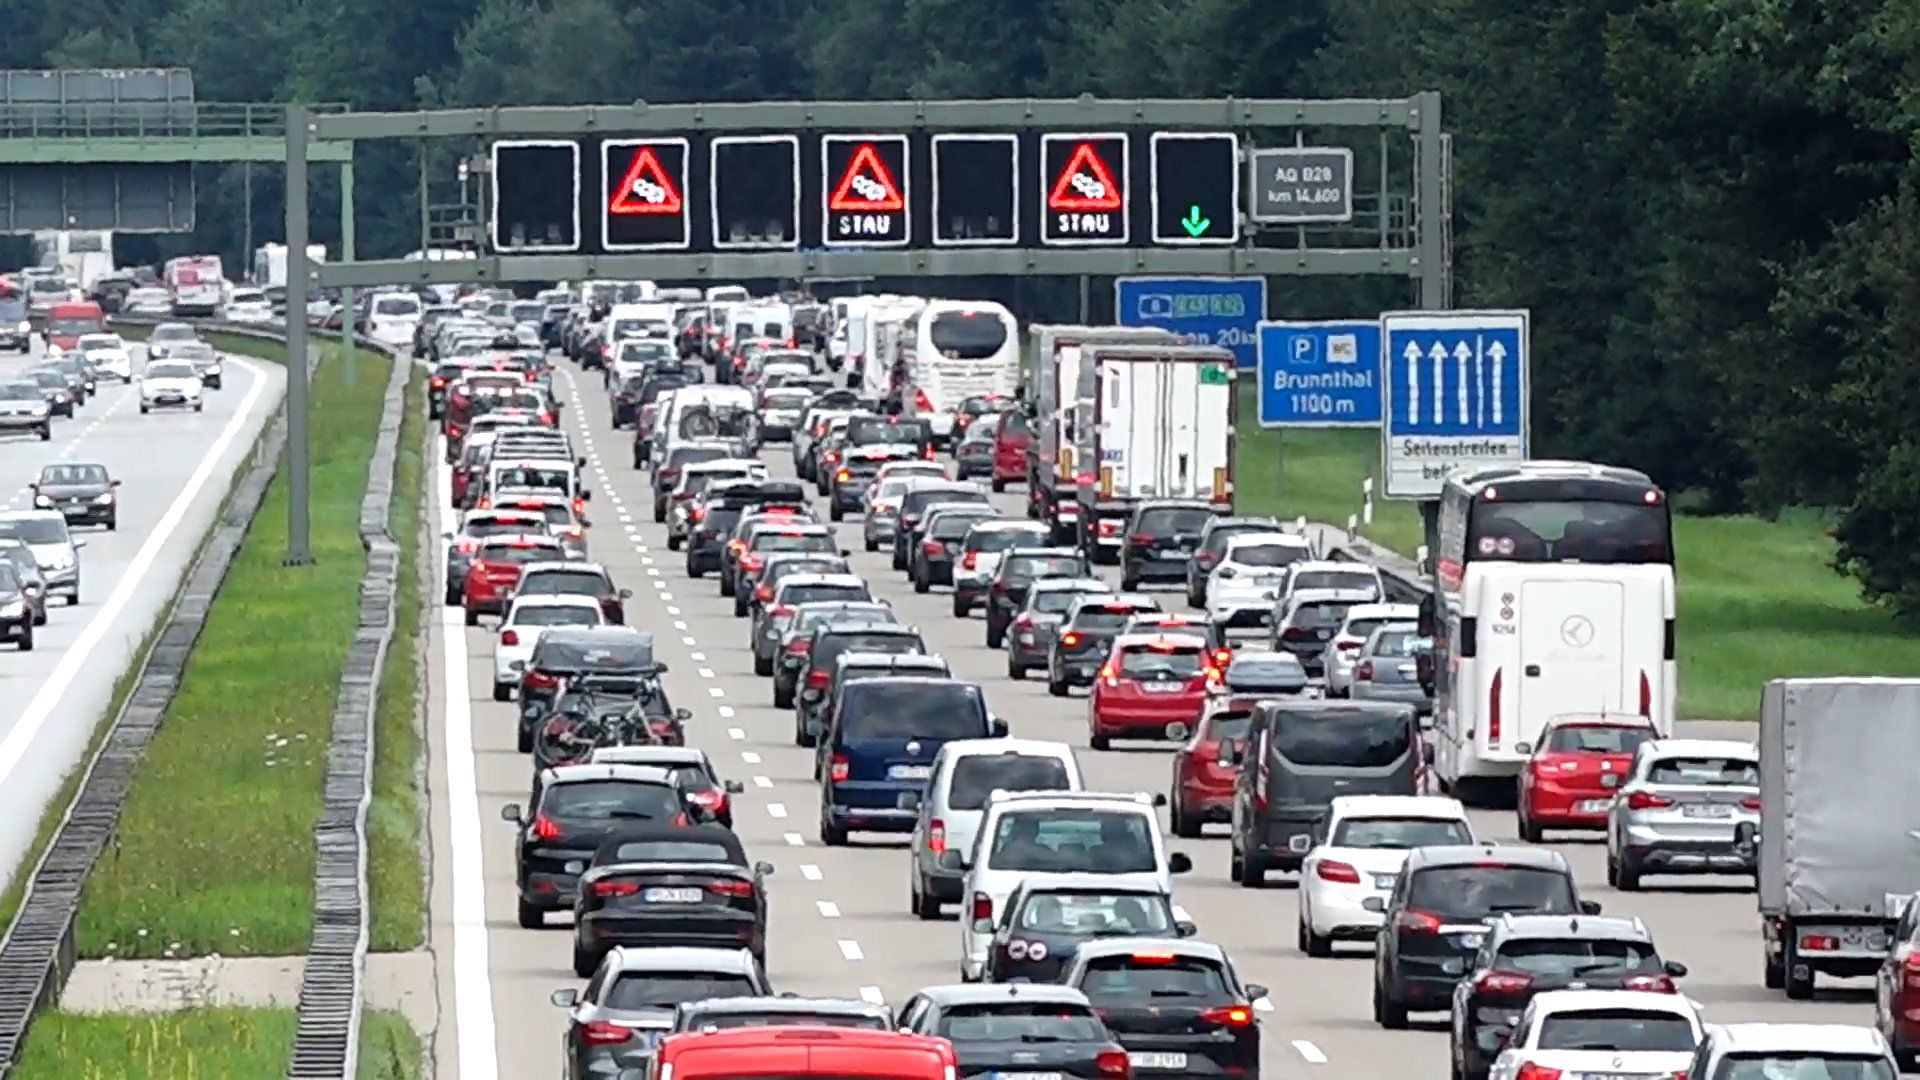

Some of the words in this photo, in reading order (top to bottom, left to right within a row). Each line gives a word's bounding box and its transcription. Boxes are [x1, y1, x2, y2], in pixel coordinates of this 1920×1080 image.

[1268, 190, 1292, 202] km
[840, 214, 890, 234] STAU
[1058, 213, 1109, 232] STAU
[1217, 327, 1240, 345] 20
[1295, 338, 1311, 359] P
[1273, 369, 1373, 391] Brunnthal
[1291, 393, 1333, 414] 1100
[1335, 399, 1355, 413] m
[1403, 438, 1508, 457] Seitenstreifen
